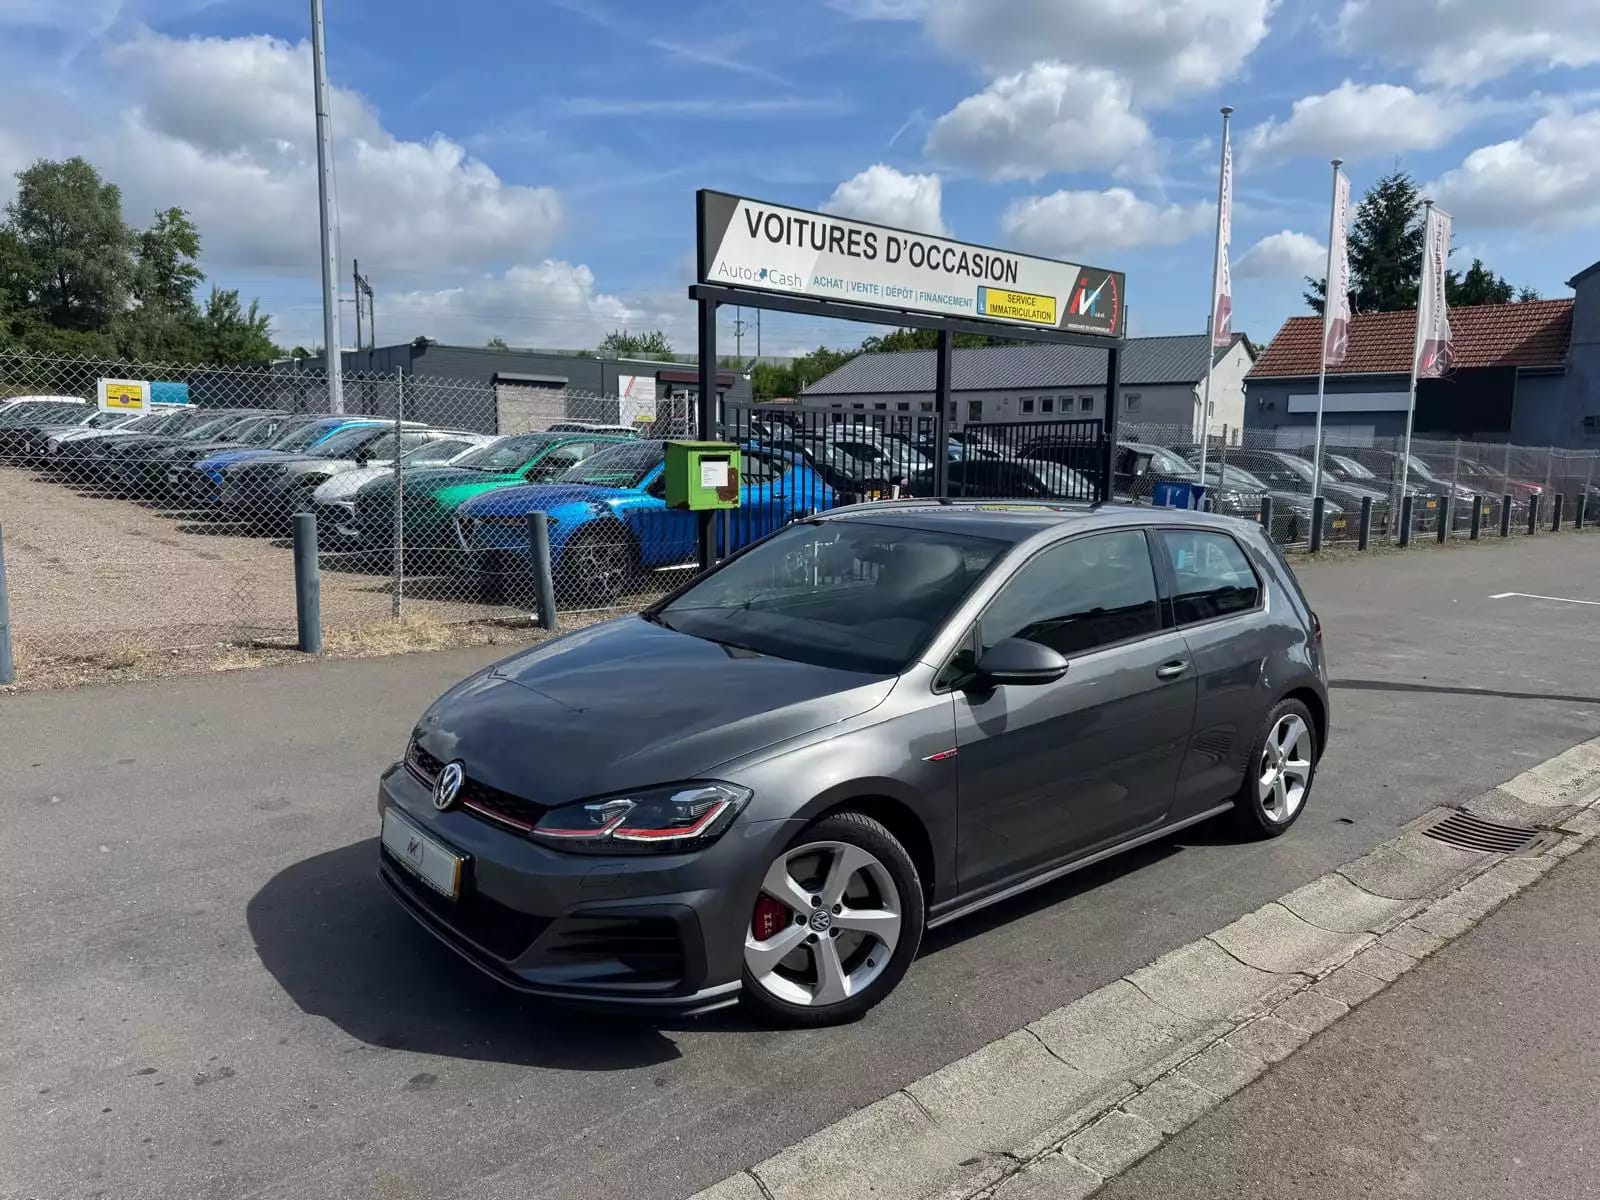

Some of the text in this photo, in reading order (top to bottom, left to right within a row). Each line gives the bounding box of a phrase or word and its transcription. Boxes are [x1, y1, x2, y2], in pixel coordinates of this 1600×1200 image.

[745, 208, 1017, 283] VOITURES D'OCCASION
[718, 261, 802, 288] Auto Cash
[813, 276, 973, 309] ACHAT VENTE DÉPÔT FINANCEMENT
[1007, 294, 1036, 307] SERVICE
[989, 303, 1052, 321] IMMATRICULATION
